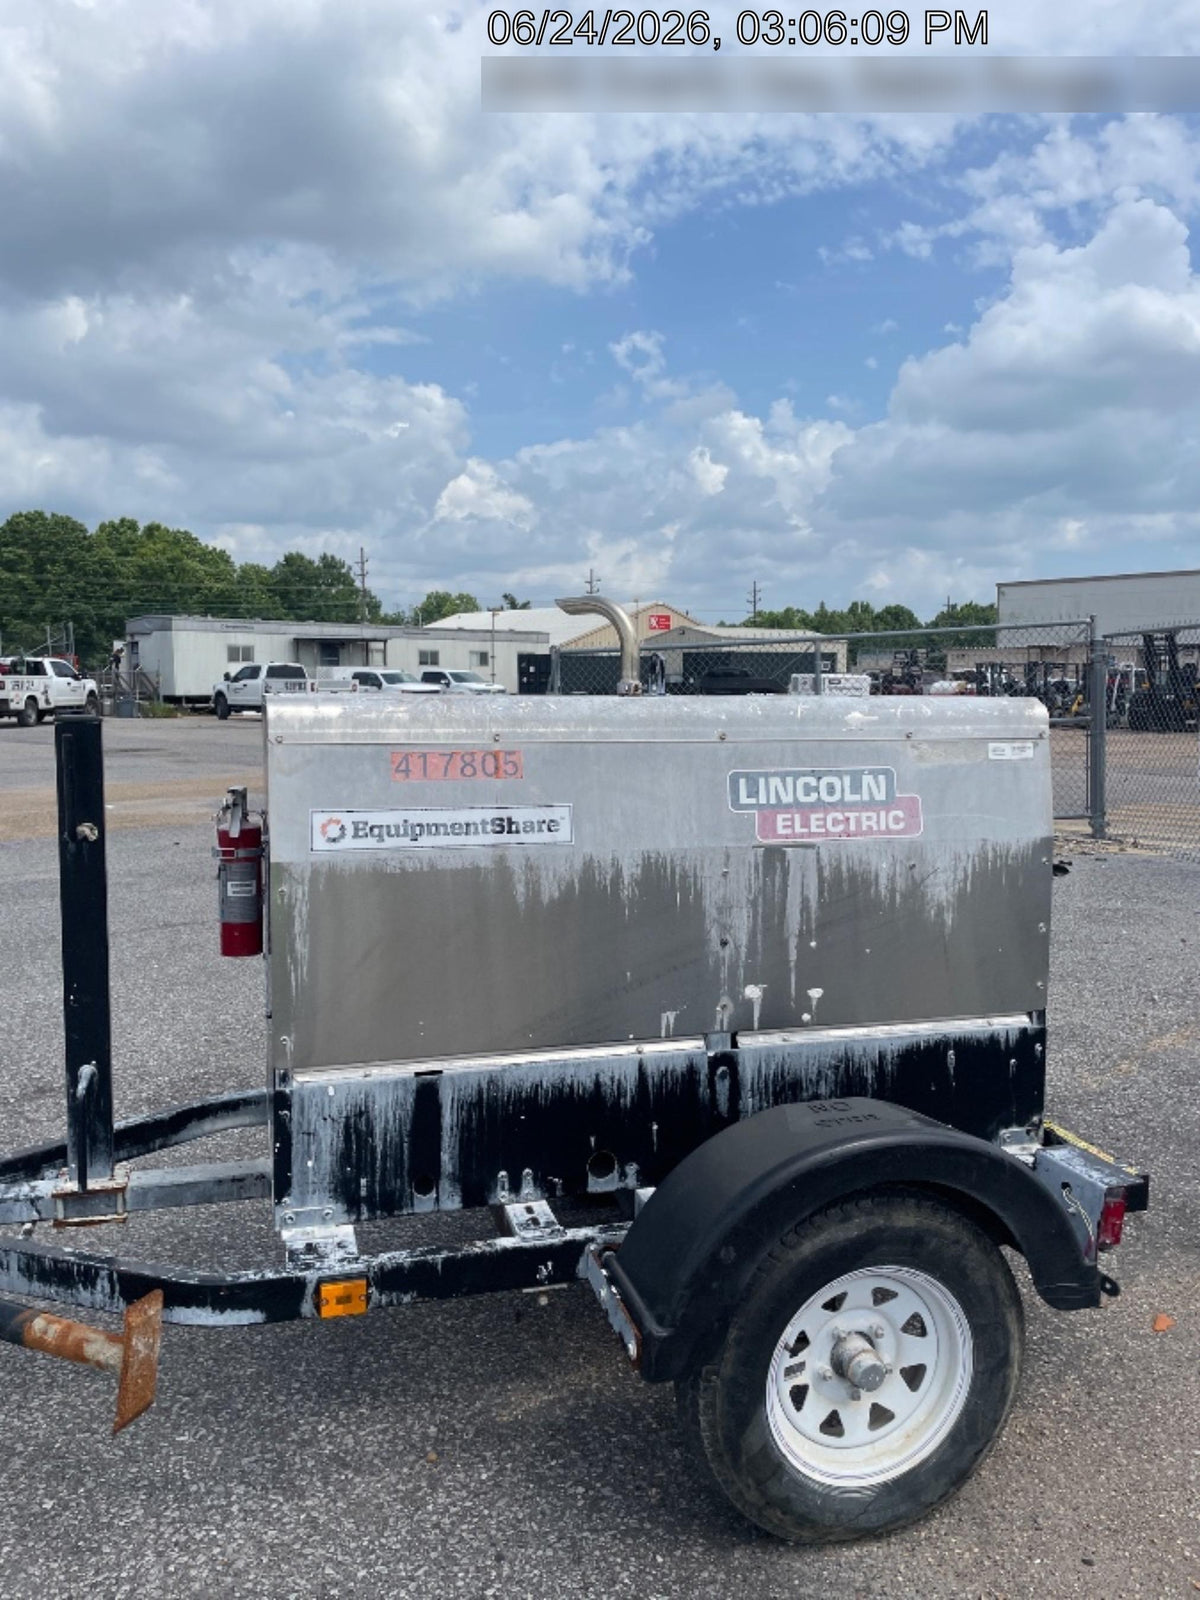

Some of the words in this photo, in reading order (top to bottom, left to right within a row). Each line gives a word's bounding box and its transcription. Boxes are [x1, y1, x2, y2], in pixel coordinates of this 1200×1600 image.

[394, 751, 519, 779] 417805
[738, 773, 887, 804] LINCOLN
[351, 816, 561, 843] EquipmentShare
[776, 810, 906, 835] ELECTRIC
